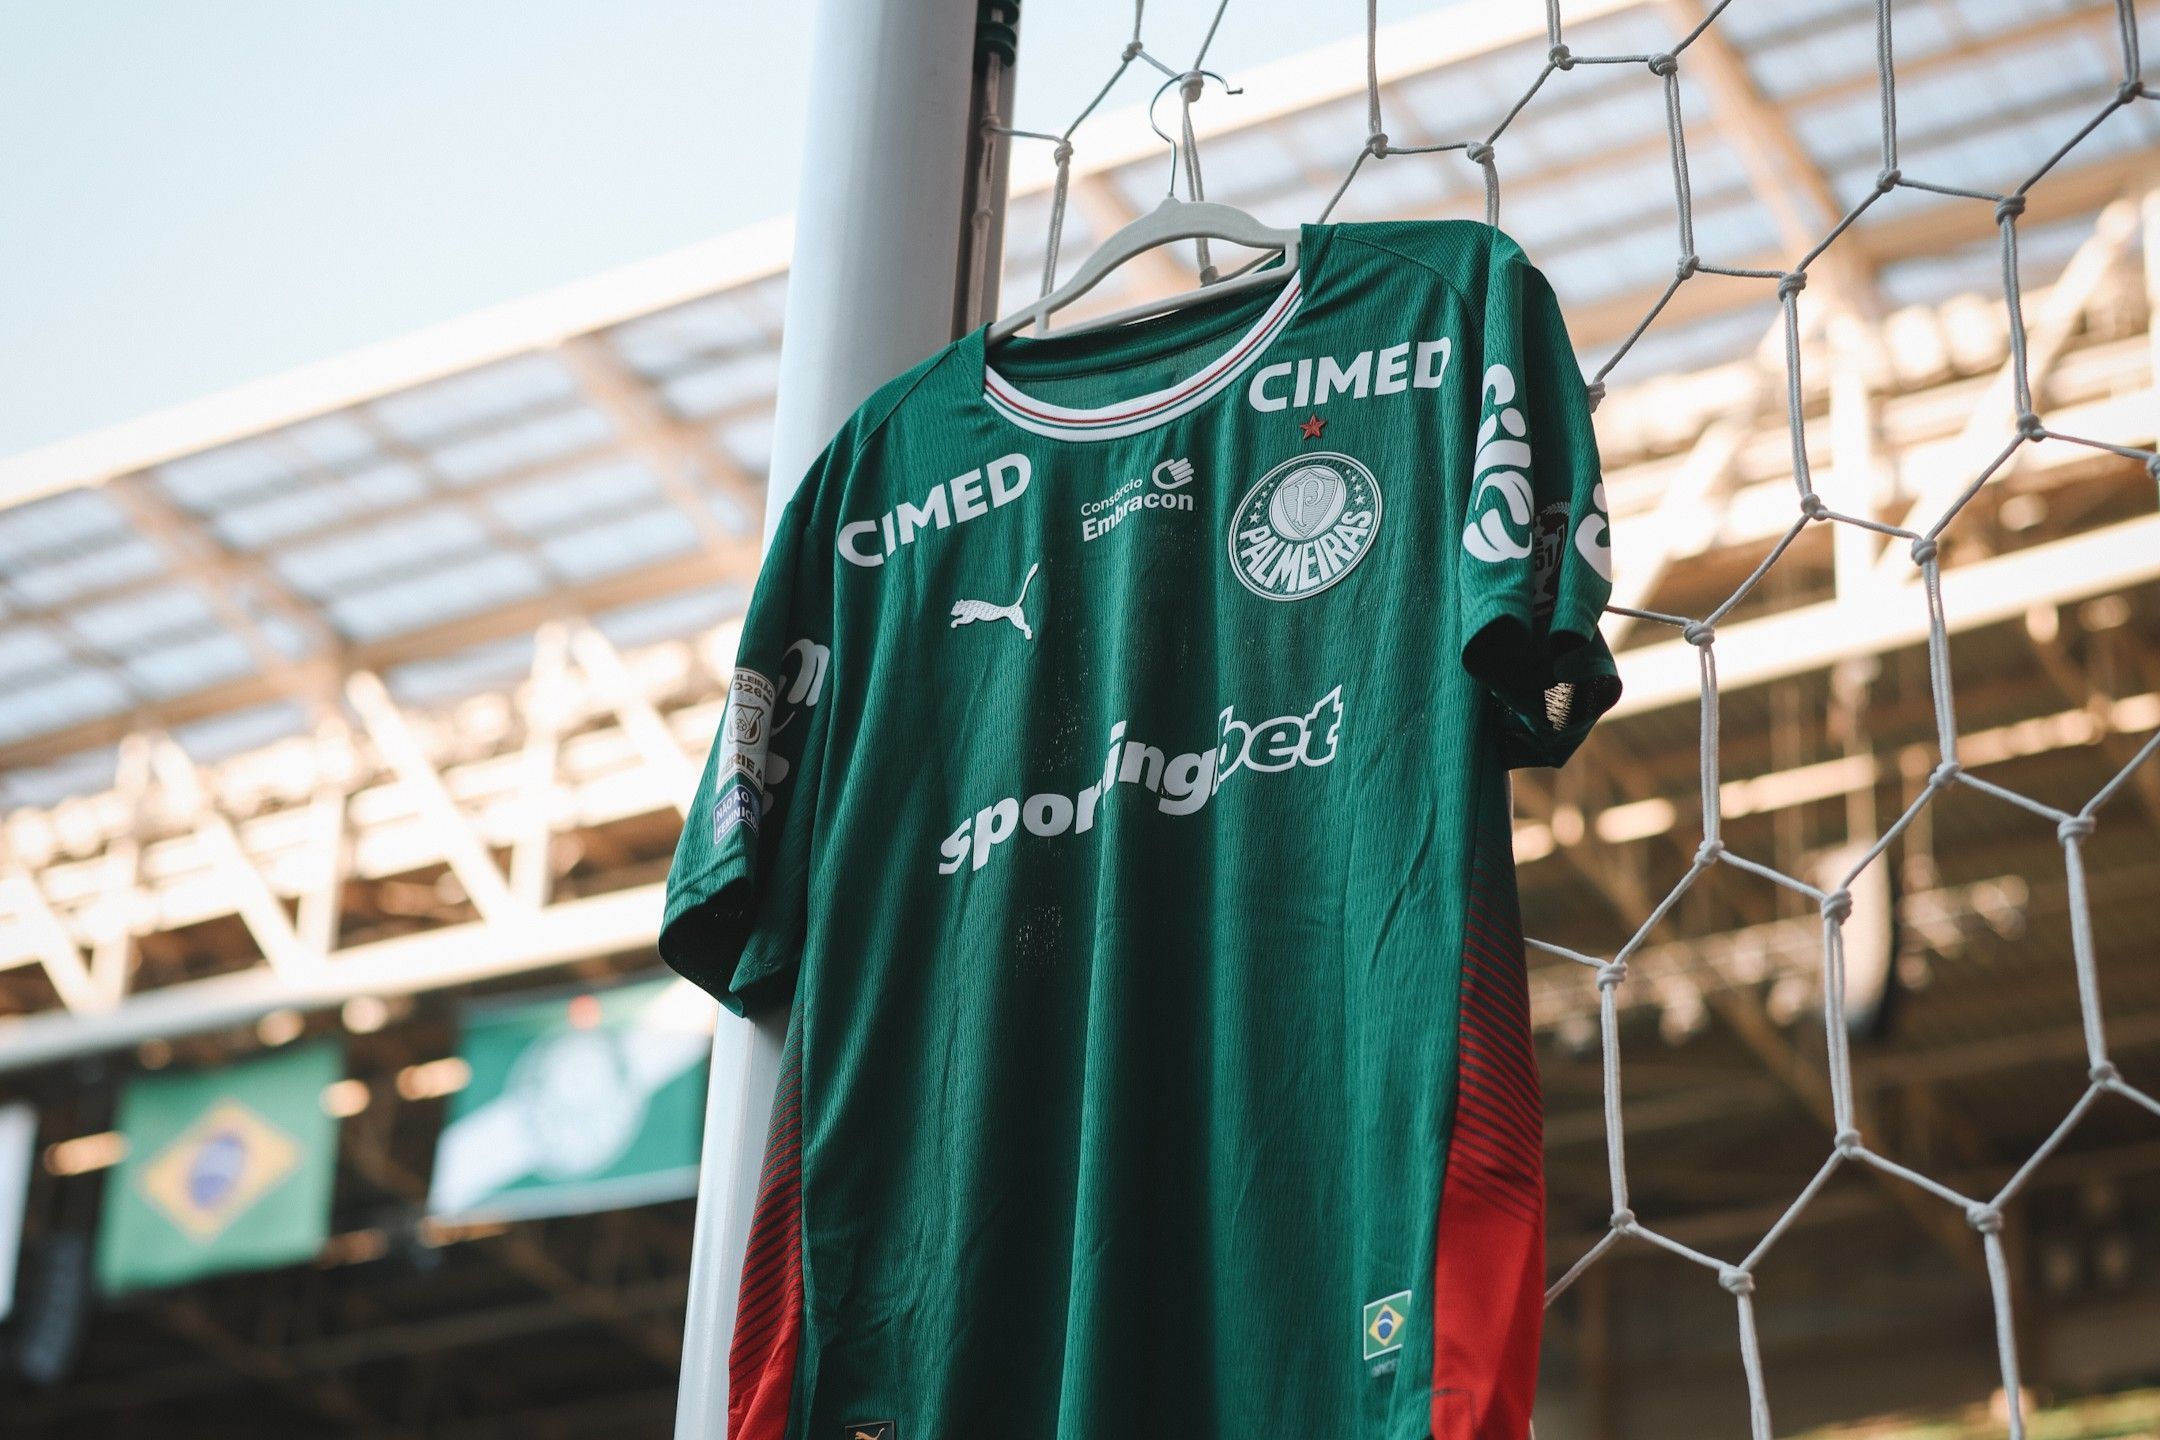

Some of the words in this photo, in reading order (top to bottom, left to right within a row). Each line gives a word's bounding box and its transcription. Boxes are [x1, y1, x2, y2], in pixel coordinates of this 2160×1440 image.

[1248, 336, 1452, 413] CIMED
[837, 452, 1032, 568] CIMED
[1080, 478, 1143, 516] Consórcio
[1082, 492, 1194, 542] Embracon
[1239, 510, 1373, 592] PALMEIRAS
[733, 681, 763, 698] 026
[938, 684, 1344, 876] sporingbet
